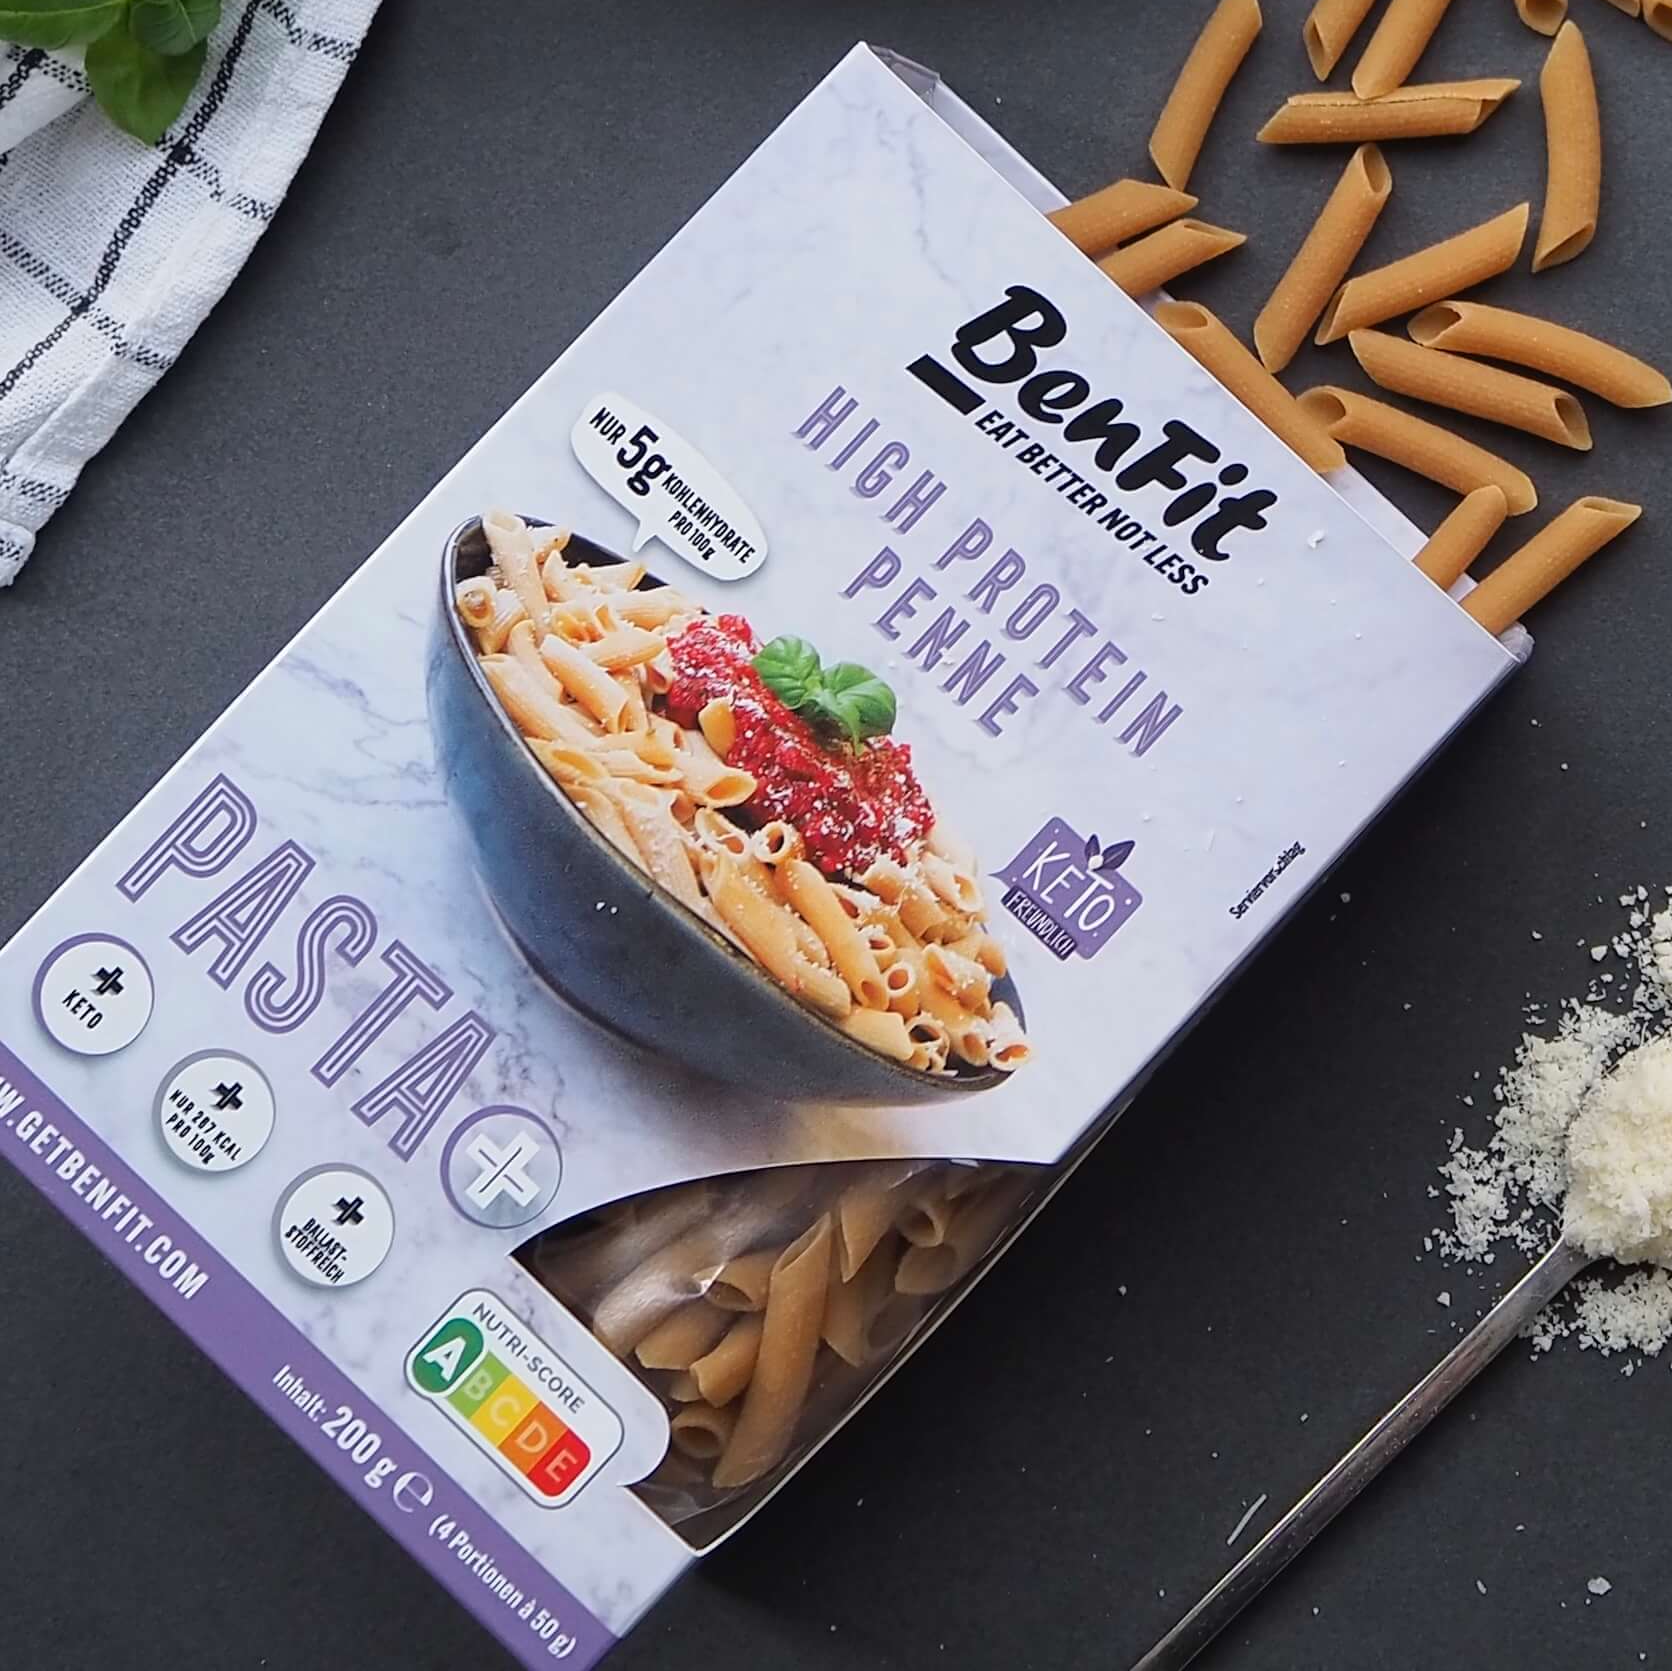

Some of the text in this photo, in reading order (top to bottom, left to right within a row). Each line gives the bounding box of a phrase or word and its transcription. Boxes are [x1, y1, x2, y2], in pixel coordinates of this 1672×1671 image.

[589, 407, 756, 564] NUR 5g KOHLENHYDRATE
[951, 285, 1278, 561] BenFit
[668, 510, 691, 536] PRO
[975, 409, 1209, 595] EAT BETTER NOT LESS
[796, 385, 1183, 758] HIGH PROTEIN
[843, 545, 1040, 736] PENNE
[1006, 889, 1075, 956] FREUNDLICH
[1022, 841, 1115, 931] KETO
[62, 989, 103, 1029] KETO
[0, 1076, 209, 1299] W.GETBENFIT.COM
[165, 1113, 191, 1138] PRO
[169, 1089, 195, 1115] NUR
[212, 1131, 241, 1161] KCAL
[285, 1225, 344, 1283] STOFFREICH
[422, 1336, 577, 1483] A B C D E
[472, 1302, 585, 1414] NUTRI-SCORE
[272, 1364, 326, 1422] Inhalt:
[320, 1406, 382, 1465] 200
[364, 1456, 398, 1489] g
[428, 1514, 457, 1541] (4
[447, 1530, 525, 1609] Portionen
[518, 1599, 536, 1621] à
[529, 1610, 559, 1646] 50
